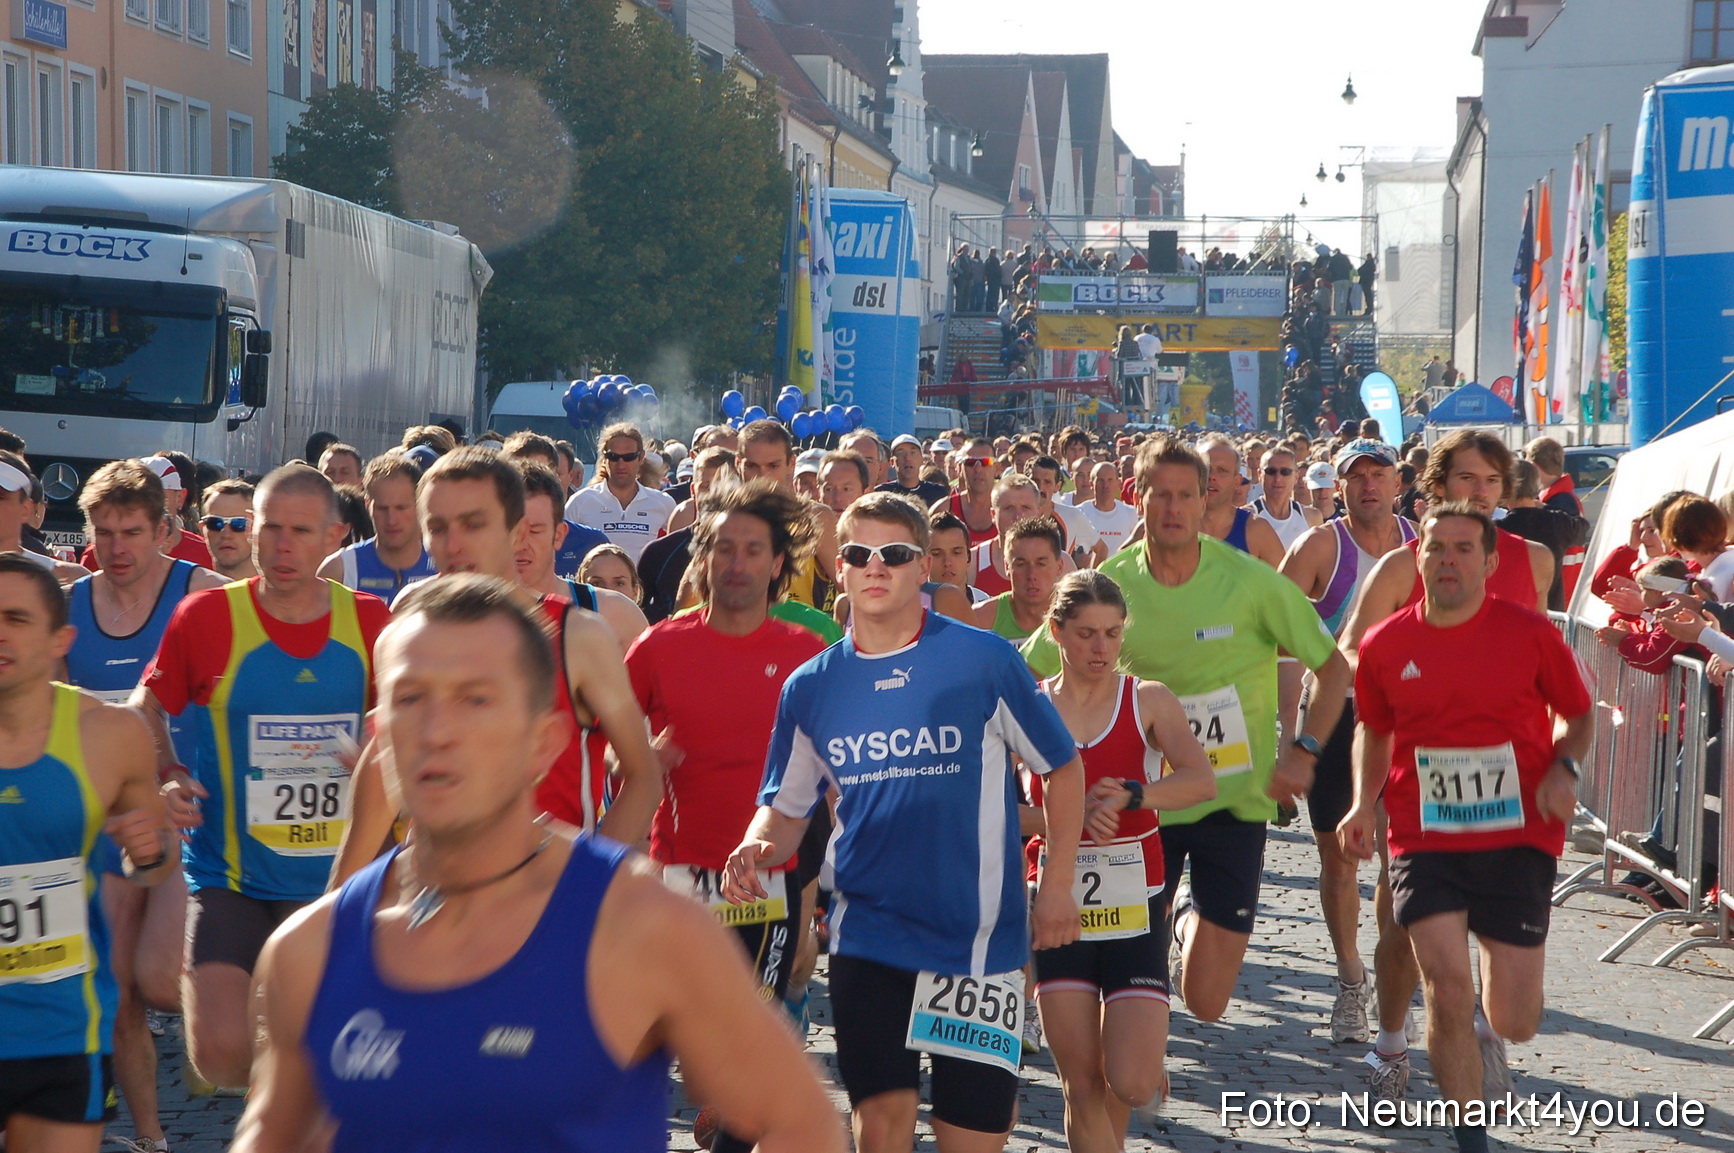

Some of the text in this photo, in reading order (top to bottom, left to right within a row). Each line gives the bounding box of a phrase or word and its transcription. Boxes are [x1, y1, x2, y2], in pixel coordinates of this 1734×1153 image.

[1678, 116, 1734, 171] m
[8, 229, 151, 262] BOCK
[831, 215, 894, 259] axi
[852, 281, 887, 308] dsl
[1074, 283, 1166, 303] BOCK
[1225, 288, 1281, 298] PFLEIDERER
[62, 533, 83, 545] 185
[874, 676, 905, 692] PUMA
[260, 724, 299, 738] LIFE
[827, 725, 962, 767] SYSCAD
[838, 762, 961, 785] www.metallbau-cad.de
[1430, 767, 1506, 804] 3117
[275, 782, 340, 820] 298
[1438, 800, 1506, 822] Manfred
[289, 822, 328, 843] Ralf
[1081, 871, 1102, 905] 2
[763, 925, 788, 988] SKINS
[928, 971, 1018, 1031] 2658
[929, 1016, 1012, 1055] Andreas
